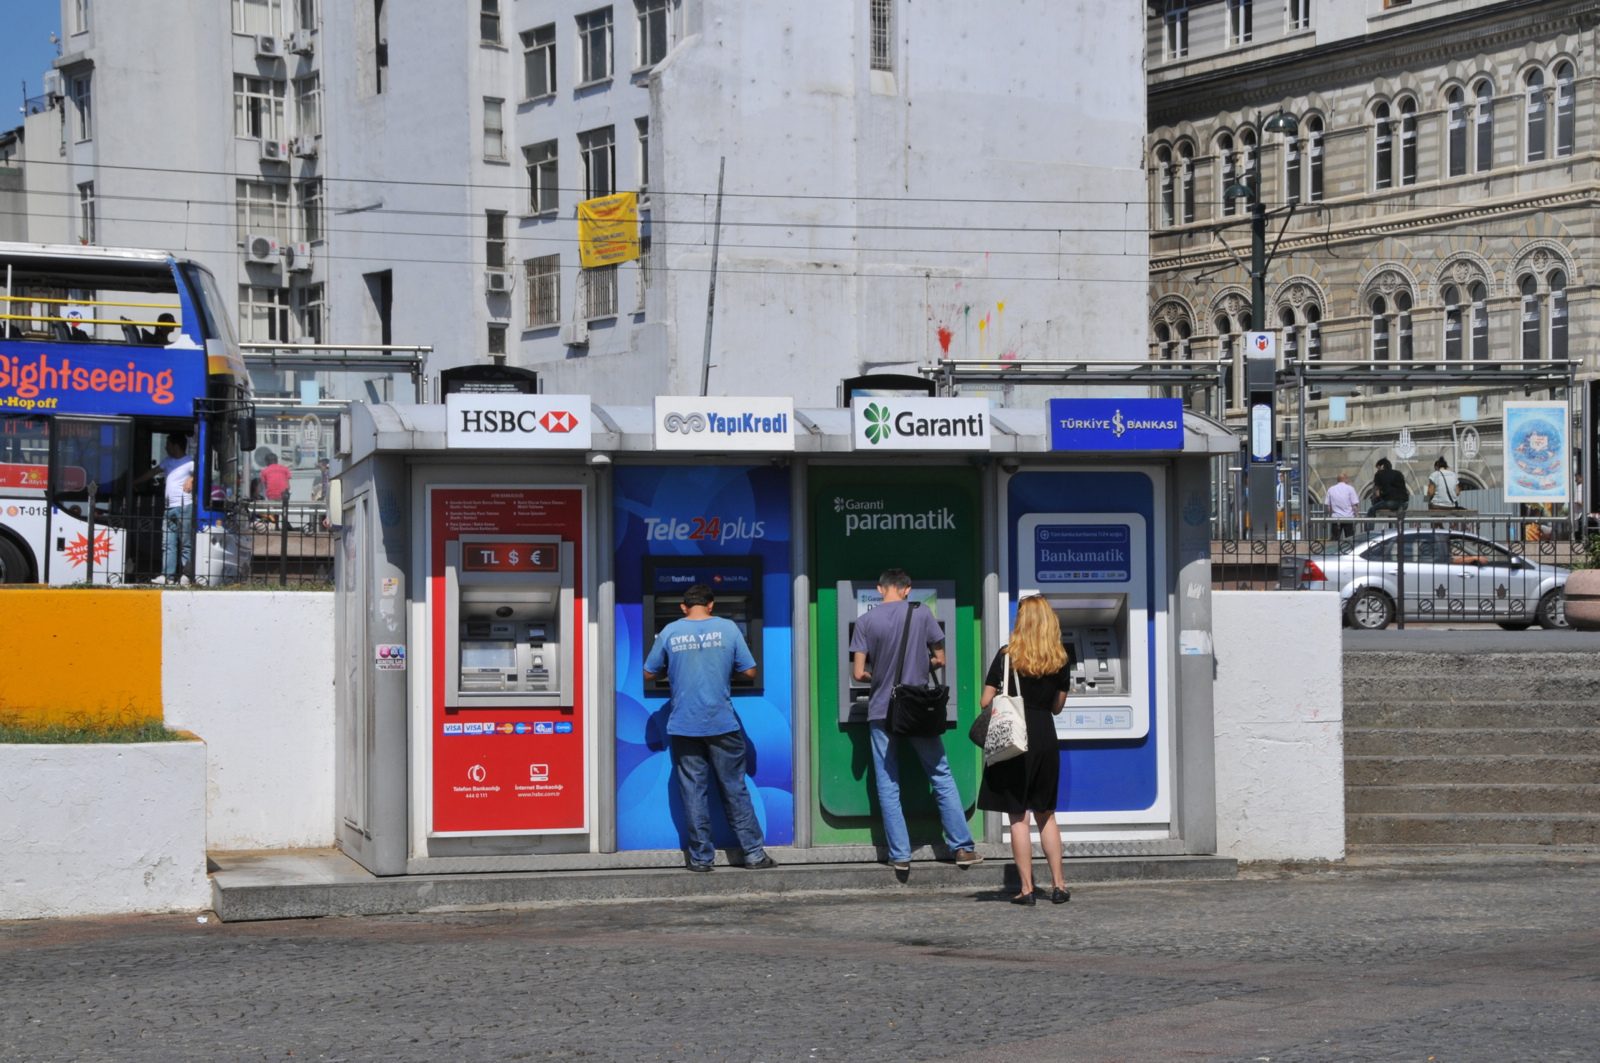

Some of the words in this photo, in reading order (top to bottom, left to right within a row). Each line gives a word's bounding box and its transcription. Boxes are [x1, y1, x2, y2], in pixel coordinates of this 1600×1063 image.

[37, 397, 58, 408] off
[461, 410, 537, 433] HSBC
[707, 412, 788, 436] YapıKredi
[895, 412, 984, 437] Garanti
[1060, 418, 1110, 429] TÜRKİYE
[1127, 419, 1178, 430] BANKASI
[845, 499, 884, 510] Garanti
[846, 507, 956, 537] paramatik
[480, 550, 499, 564] TL
[1040, 549, 1124, 562] Bankamatik
[698, 631, 722, 642] YAPI
